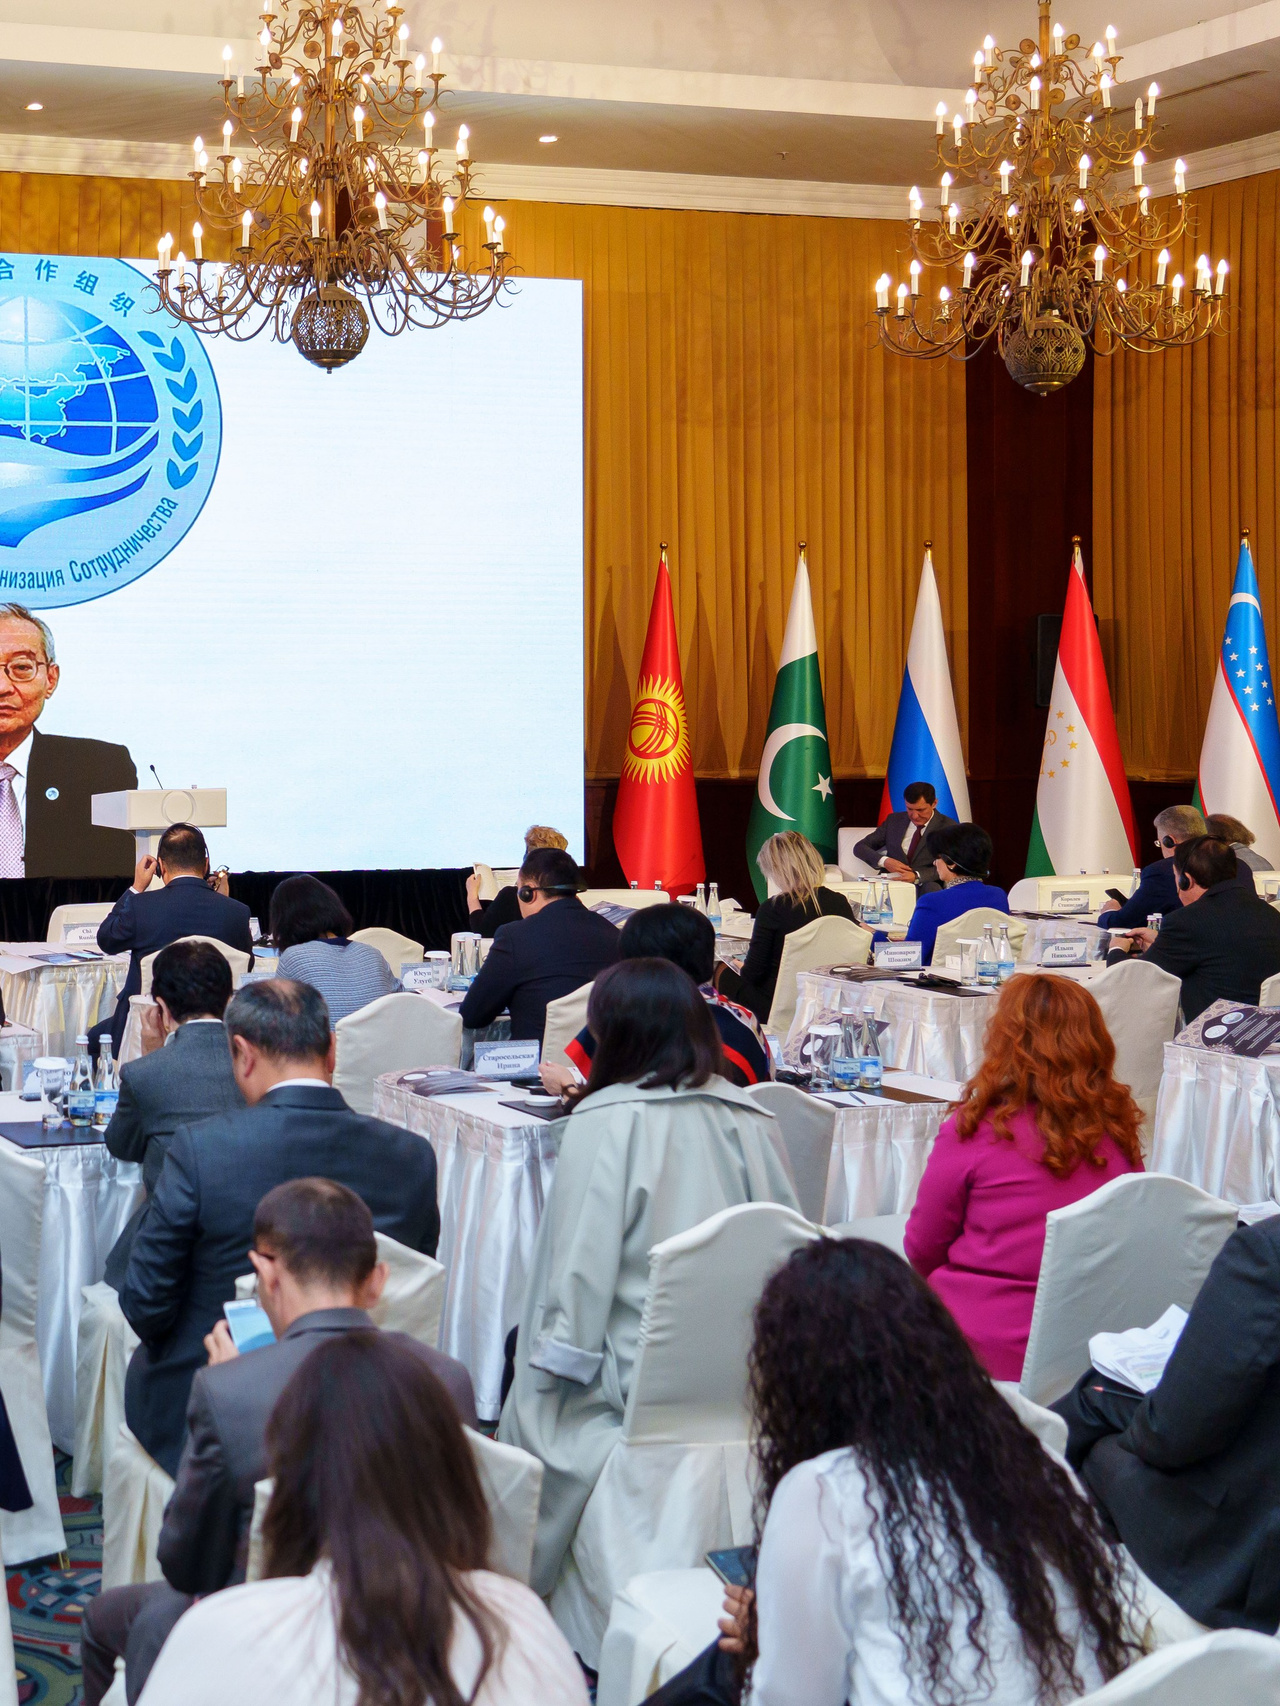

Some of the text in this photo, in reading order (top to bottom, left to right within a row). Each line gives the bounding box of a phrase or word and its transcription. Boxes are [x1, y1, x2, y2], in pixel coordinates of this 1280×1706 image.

[68, 495, 180, 585] Сотрудничества
[482, 1053, 535, 1062] Старосельская
[496, 1062, 521, 1070] Ирина
